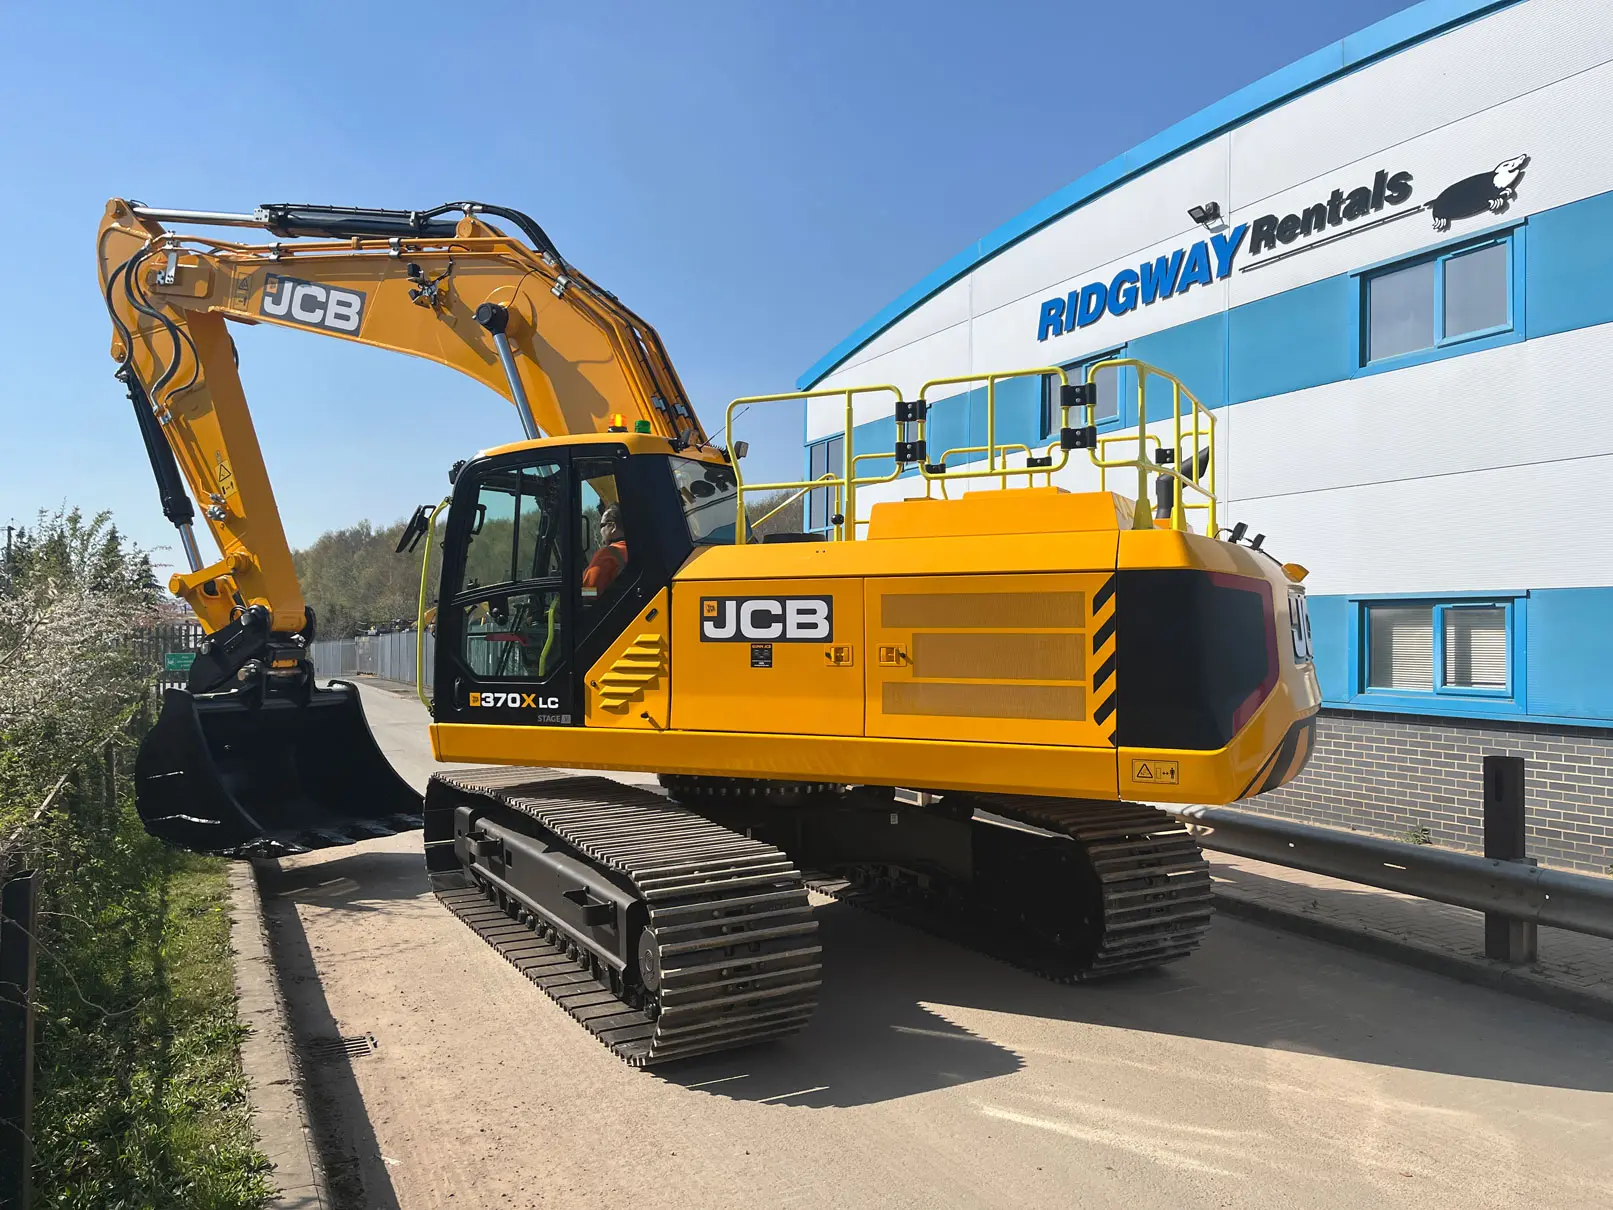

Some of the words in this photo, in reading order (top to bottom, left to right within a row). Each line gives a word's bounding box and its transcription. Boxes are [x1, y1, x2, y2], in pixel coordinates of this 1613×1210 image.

[1037, 222, 1249, 342] RIDGWAY
[1249, 169, 1413, 256] Rentals
[263, 280, 361, 331] JCB
[703, 599, 830, 639] JCB
[481, 692, 536, 708] 370X
[538, 697, 559, 709] LC
[538, 714, 560, 723] STAGE
